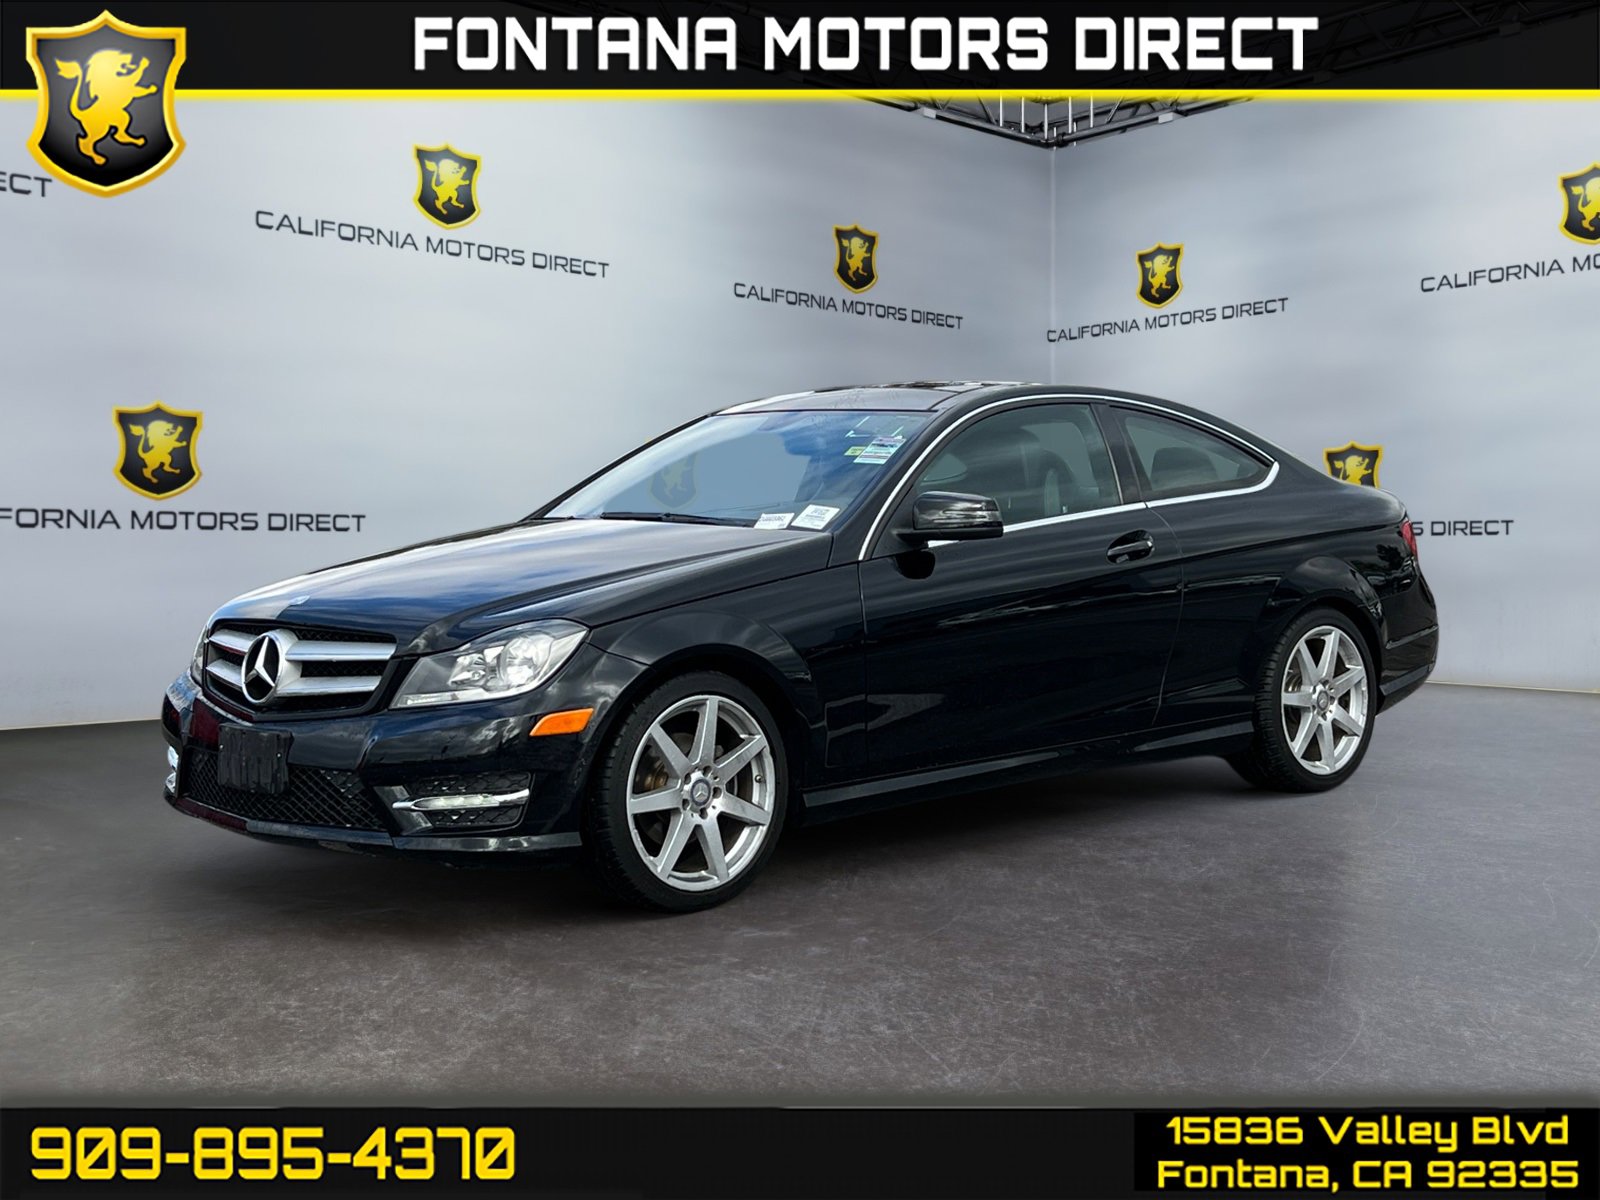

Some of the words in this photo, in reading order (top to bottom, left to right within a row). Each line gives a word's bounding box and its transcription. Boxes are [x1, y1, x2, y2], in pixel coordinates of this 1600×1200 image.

[254, 209, 419, 252] CALIFORNIA
[425, 235, 526, 267] MOTORS
[531, 251, 610, 279] DIRECT
[1420, 258, 1566, 293] CALIFORNIA
[733, 282, 839, 313] CALIFORNIA
[841, 298, 908, 322] MOTORS
[910, 308, 964, 330] DIRECT
[1046, 318, 1141, 344] CALIFORNIA
[1144, 307, 1218, 331] MOTORS
[1221, 296, 1289, 320] DIRECT
[130, 509, 260, 532] MOTORS
[267, 512, 367, 533] DIRECT
[1430, 519, 1515, 537] DIRECT
